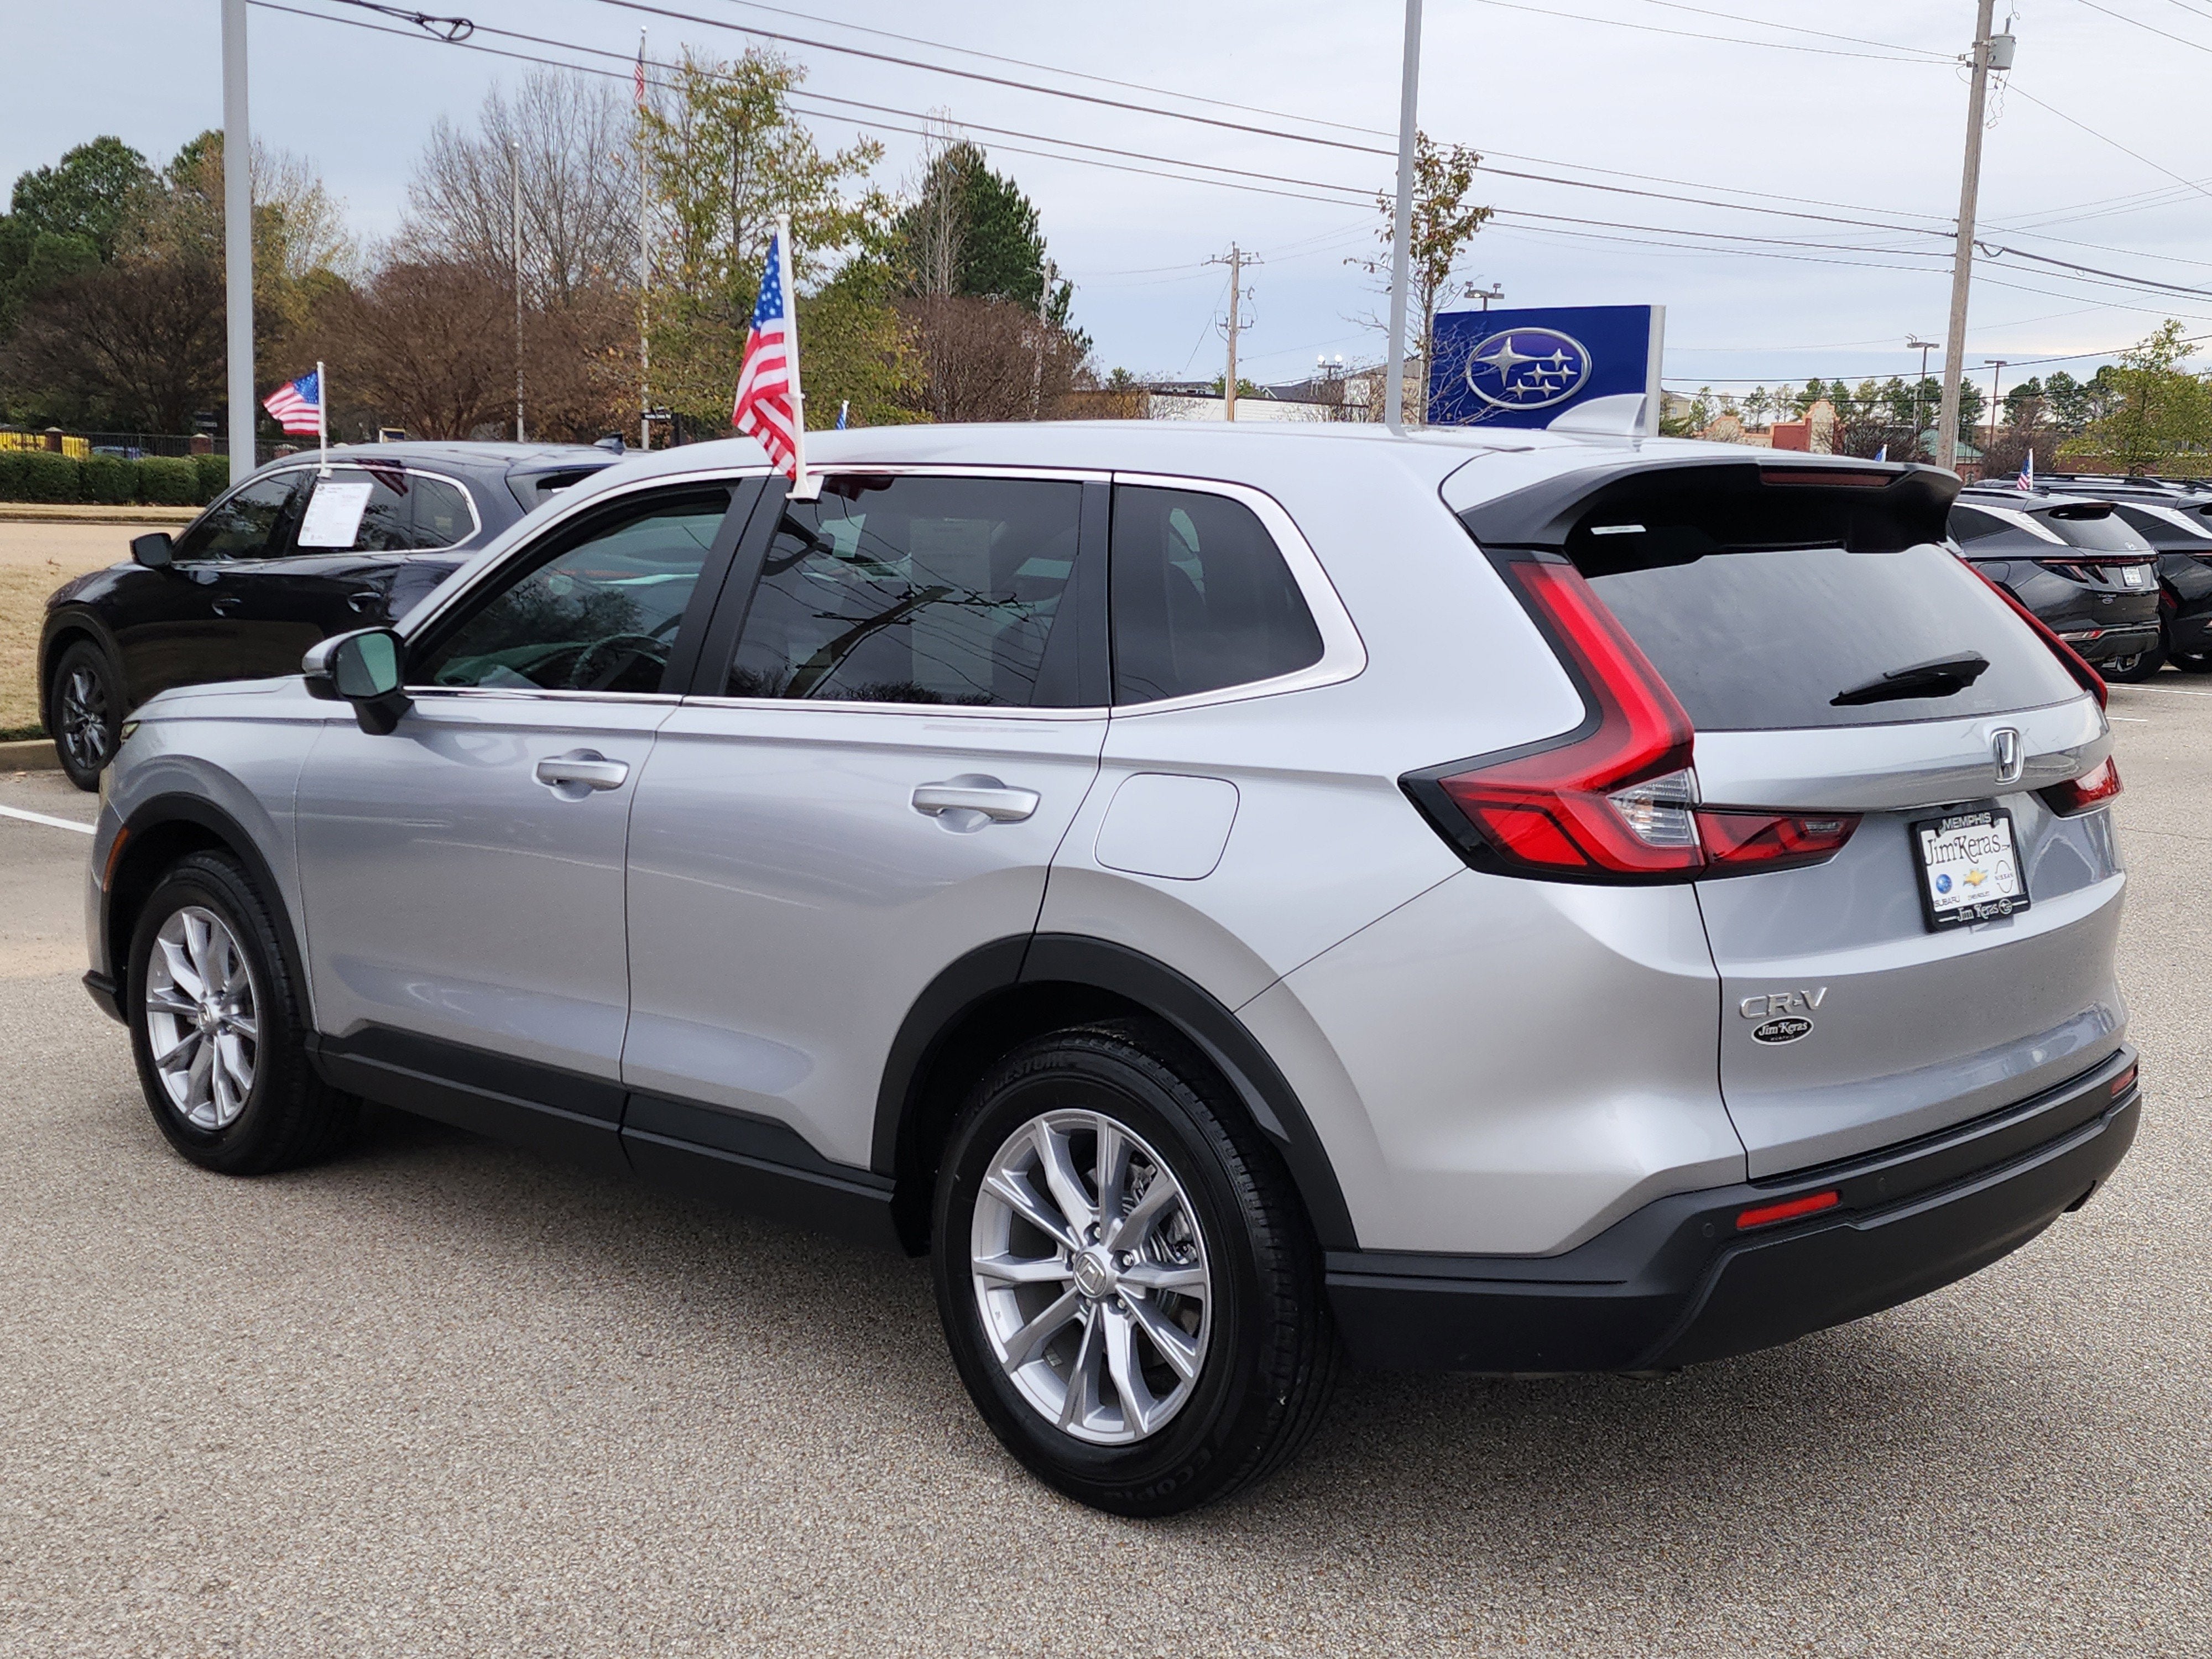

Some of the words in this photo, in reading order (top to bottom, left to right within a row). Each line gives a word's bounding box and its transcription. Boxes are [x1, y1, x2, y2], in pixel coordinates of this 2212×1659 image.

[1942, 812, 1991, 830] MEMPHIS
[1957, 907, 1974, 922] Jim
[1974, 904, 1999, 919] Keras
[1740, 987, 1827, 1019] CR-V
[1759, 1025, 1778, 1036] Jim
[1778, 1022, 1808, 1035] Keras
